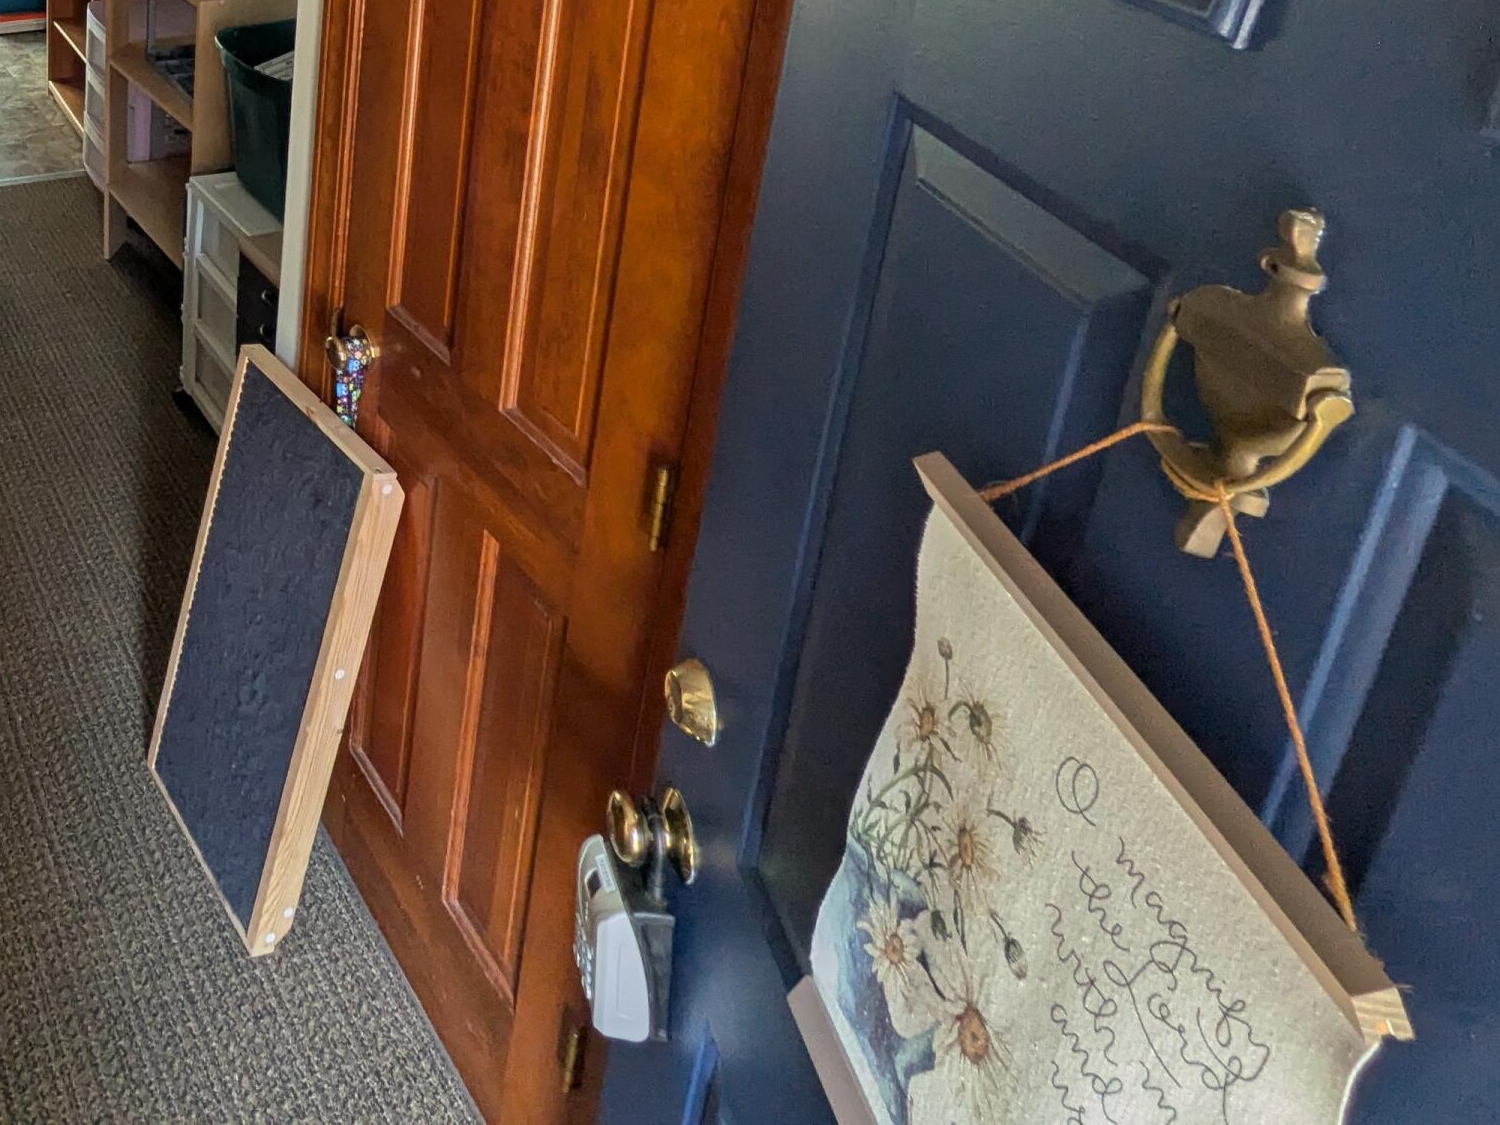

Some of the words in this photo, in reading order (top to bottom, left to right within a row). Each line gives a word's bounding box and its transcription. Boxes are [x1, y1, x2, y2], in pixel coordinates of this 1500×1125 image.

[1045, 903, 1118, 1067] with
[1056, 756, 1099, 826] O
[1116, 836, 1270, 1082] magnify
[1071, 851, 1130, 952] the
[1104, 960, 1243, 1125] Lord
[1051, 1003, 1122, 1125] and
